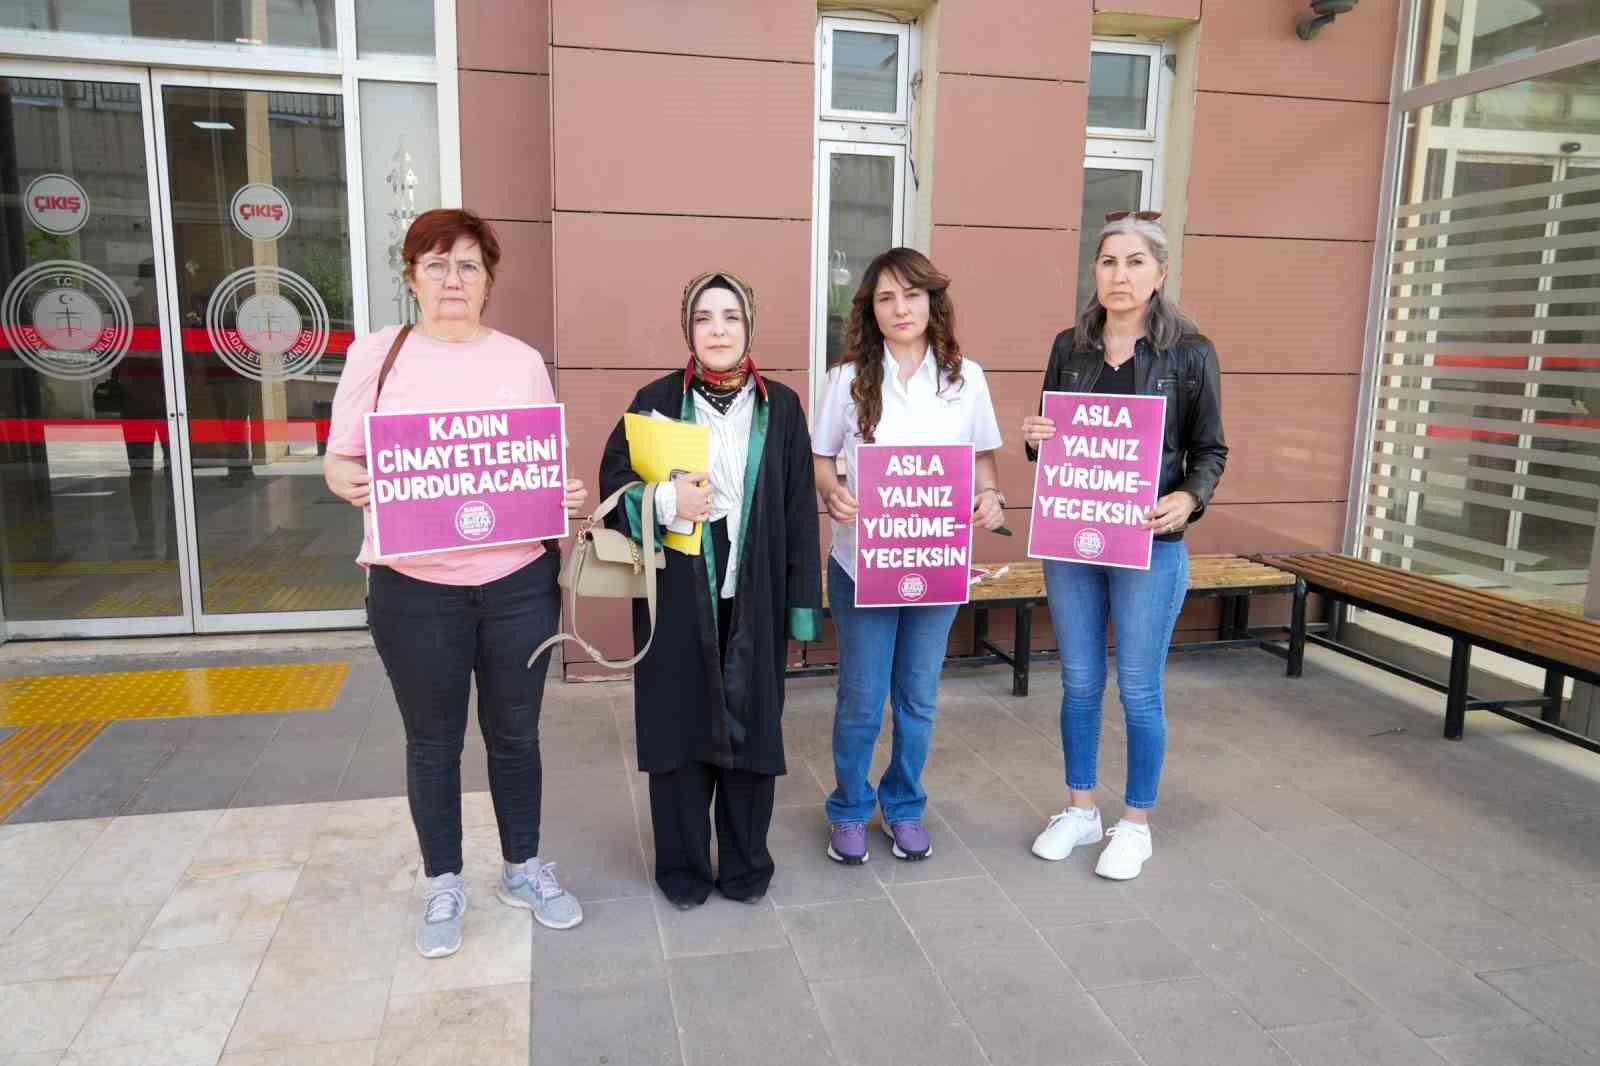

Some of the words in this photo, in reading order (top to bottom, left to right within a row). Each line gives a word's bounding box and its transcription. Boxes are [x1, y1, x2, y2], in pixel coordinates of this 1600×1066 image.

[33, 195, 81, 213] ÇIKIŞ
[239, 203, 283, 221] ÇIKIŞ
[429, 413, 509, 441] KADIN
[1072, 404, 1132, 428] ASLA
[377, 434, 557, 474] CİNAYETLERİNİ
[1062, 435, 1140, 461] YALNIZ
[885, 455, 945, 476] ASLA
[1044, 463, 1152, 493] YÜRÜME-
[375, 463, 562, 504] DURDURACAĞIZ
[877, 486, 953, 508] YALNIZ
[1038, 495, 1150, 526] YECEKSİN
[863, 514, 966, 539] YÜRÜME-
[860, 544, 967, 569] YECEKSİN
